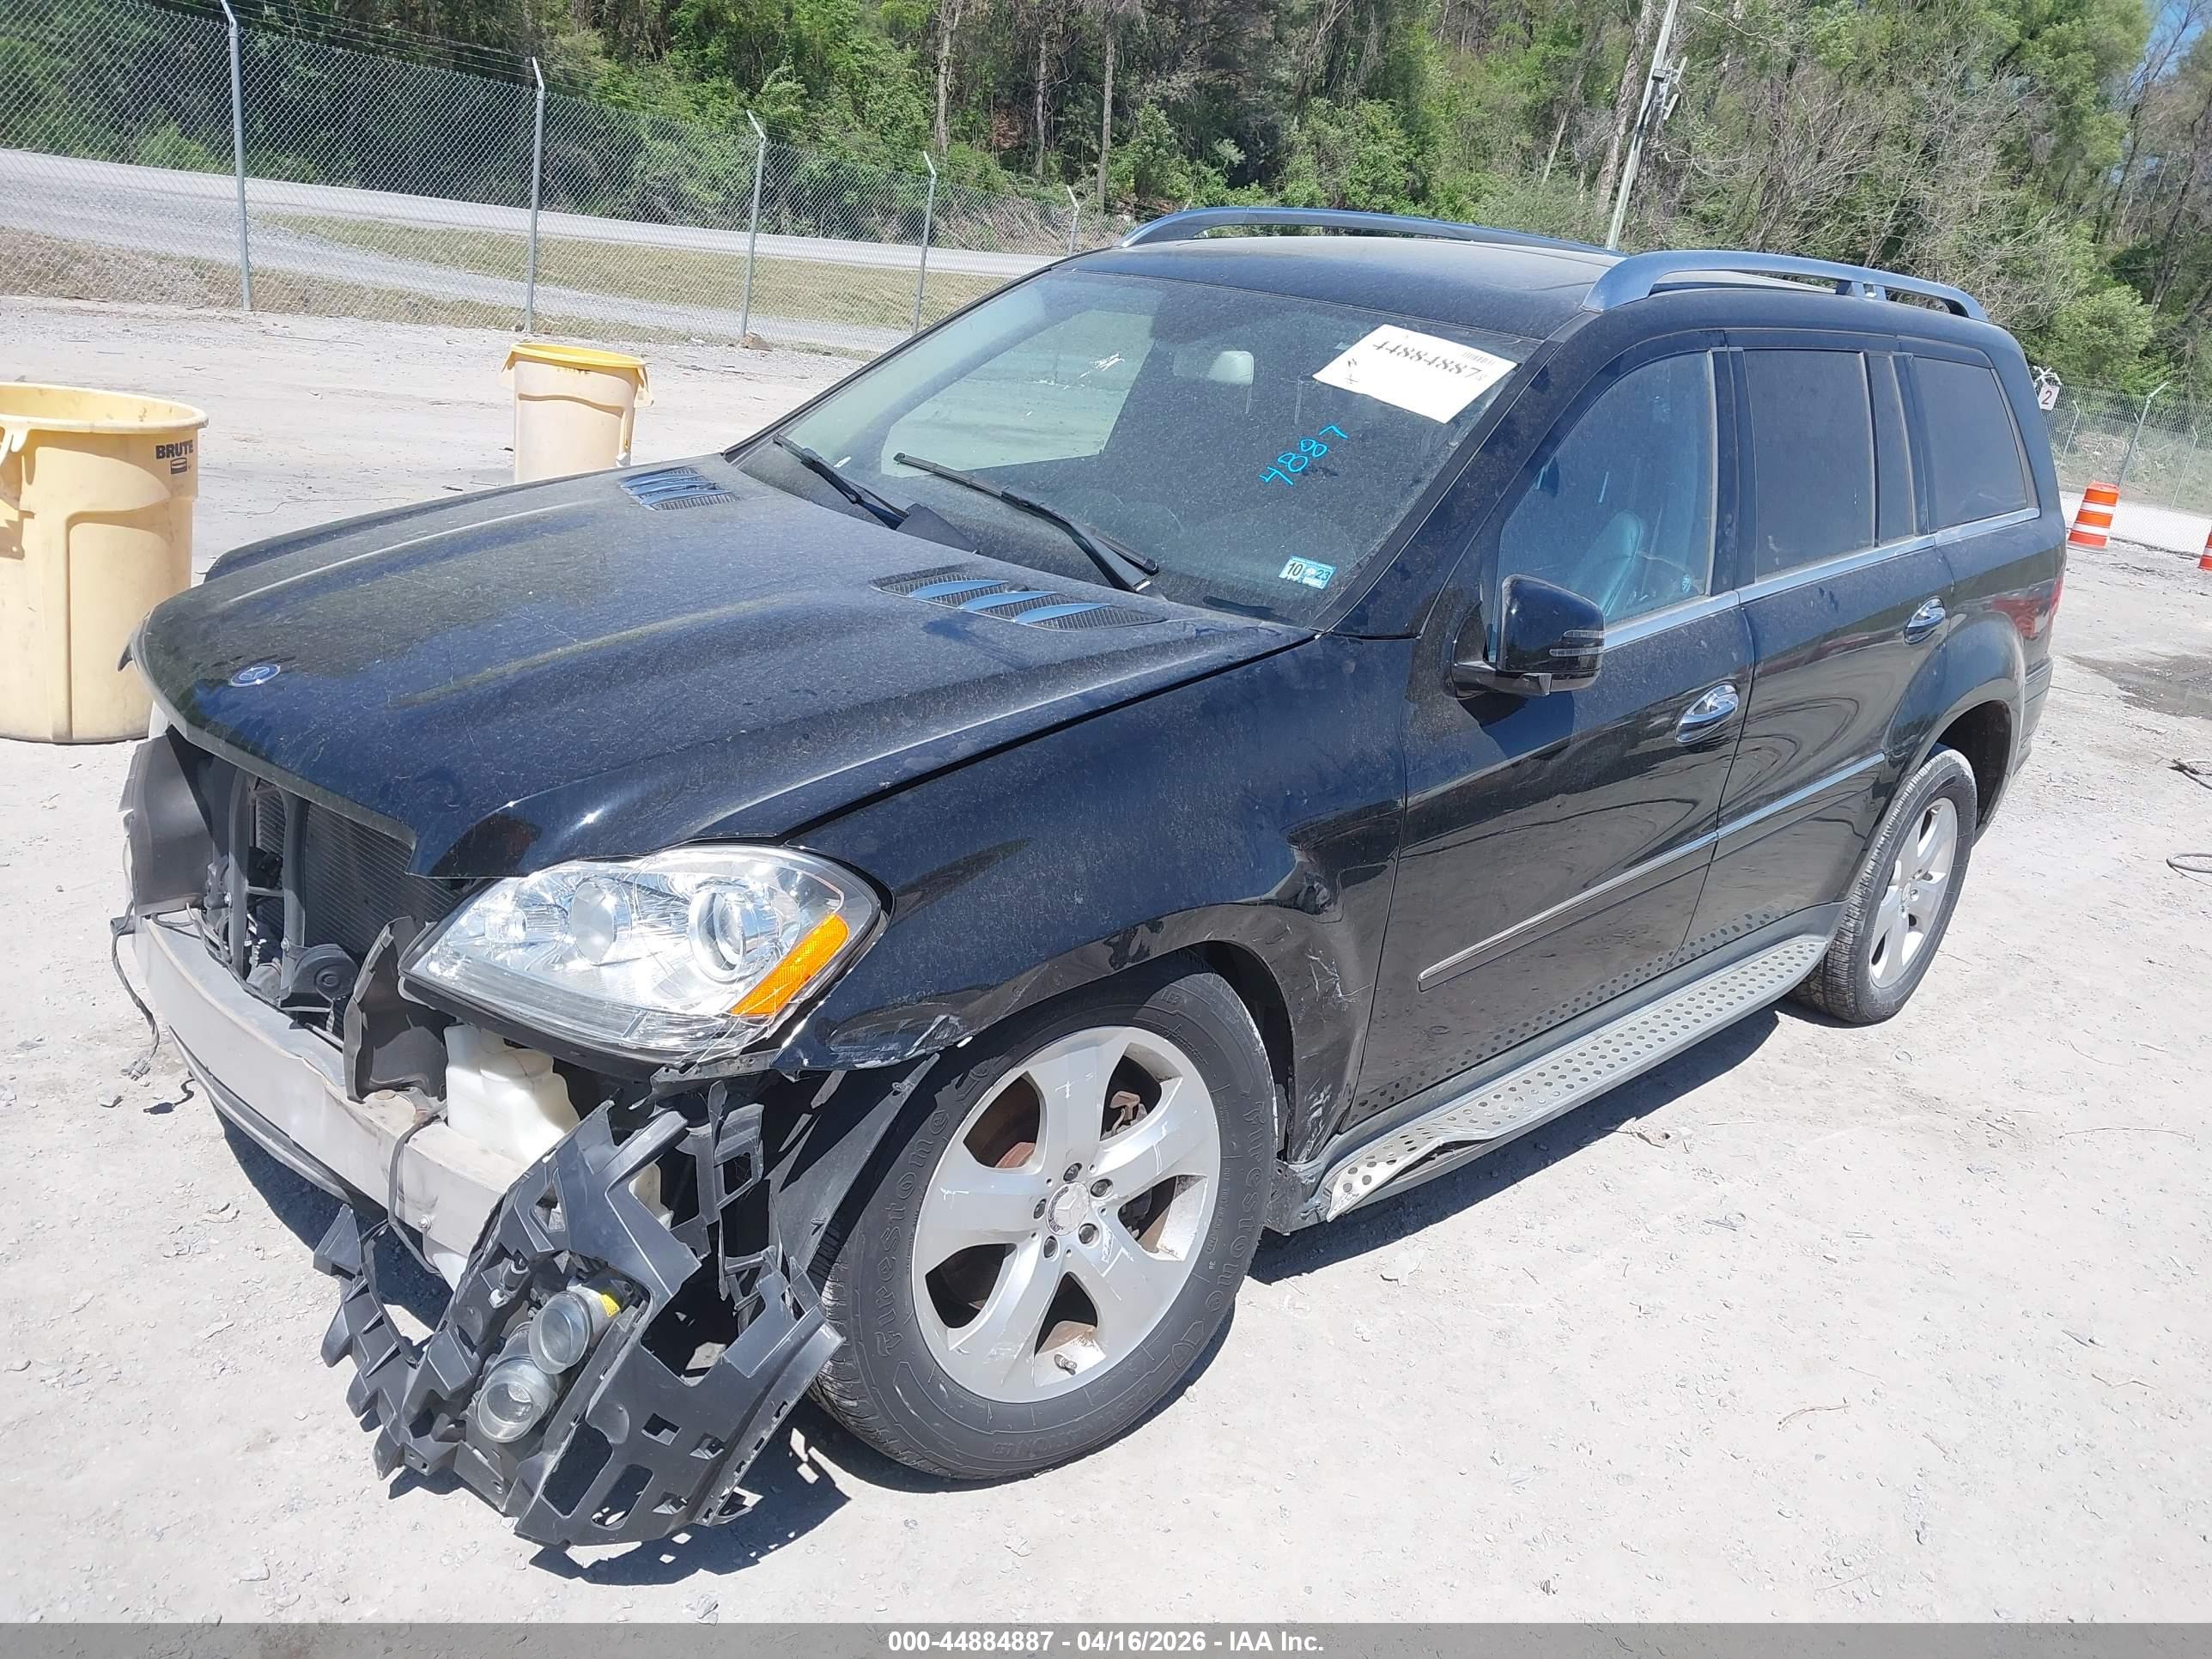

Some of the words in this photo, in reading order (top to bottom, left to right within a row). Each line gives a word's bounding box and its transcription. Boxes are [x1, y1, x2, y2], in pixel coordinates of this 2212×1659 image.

[1372, 341, 1482, 378] 44884887
[2041, 390, 2052, 405] 2
[155, 439, 194, 459] BRUTE
[1259, 424, 1348, 485] 4887
[1288, 562, 1303, 576] 10
[874, 1104, 951, 1358] Firestone
